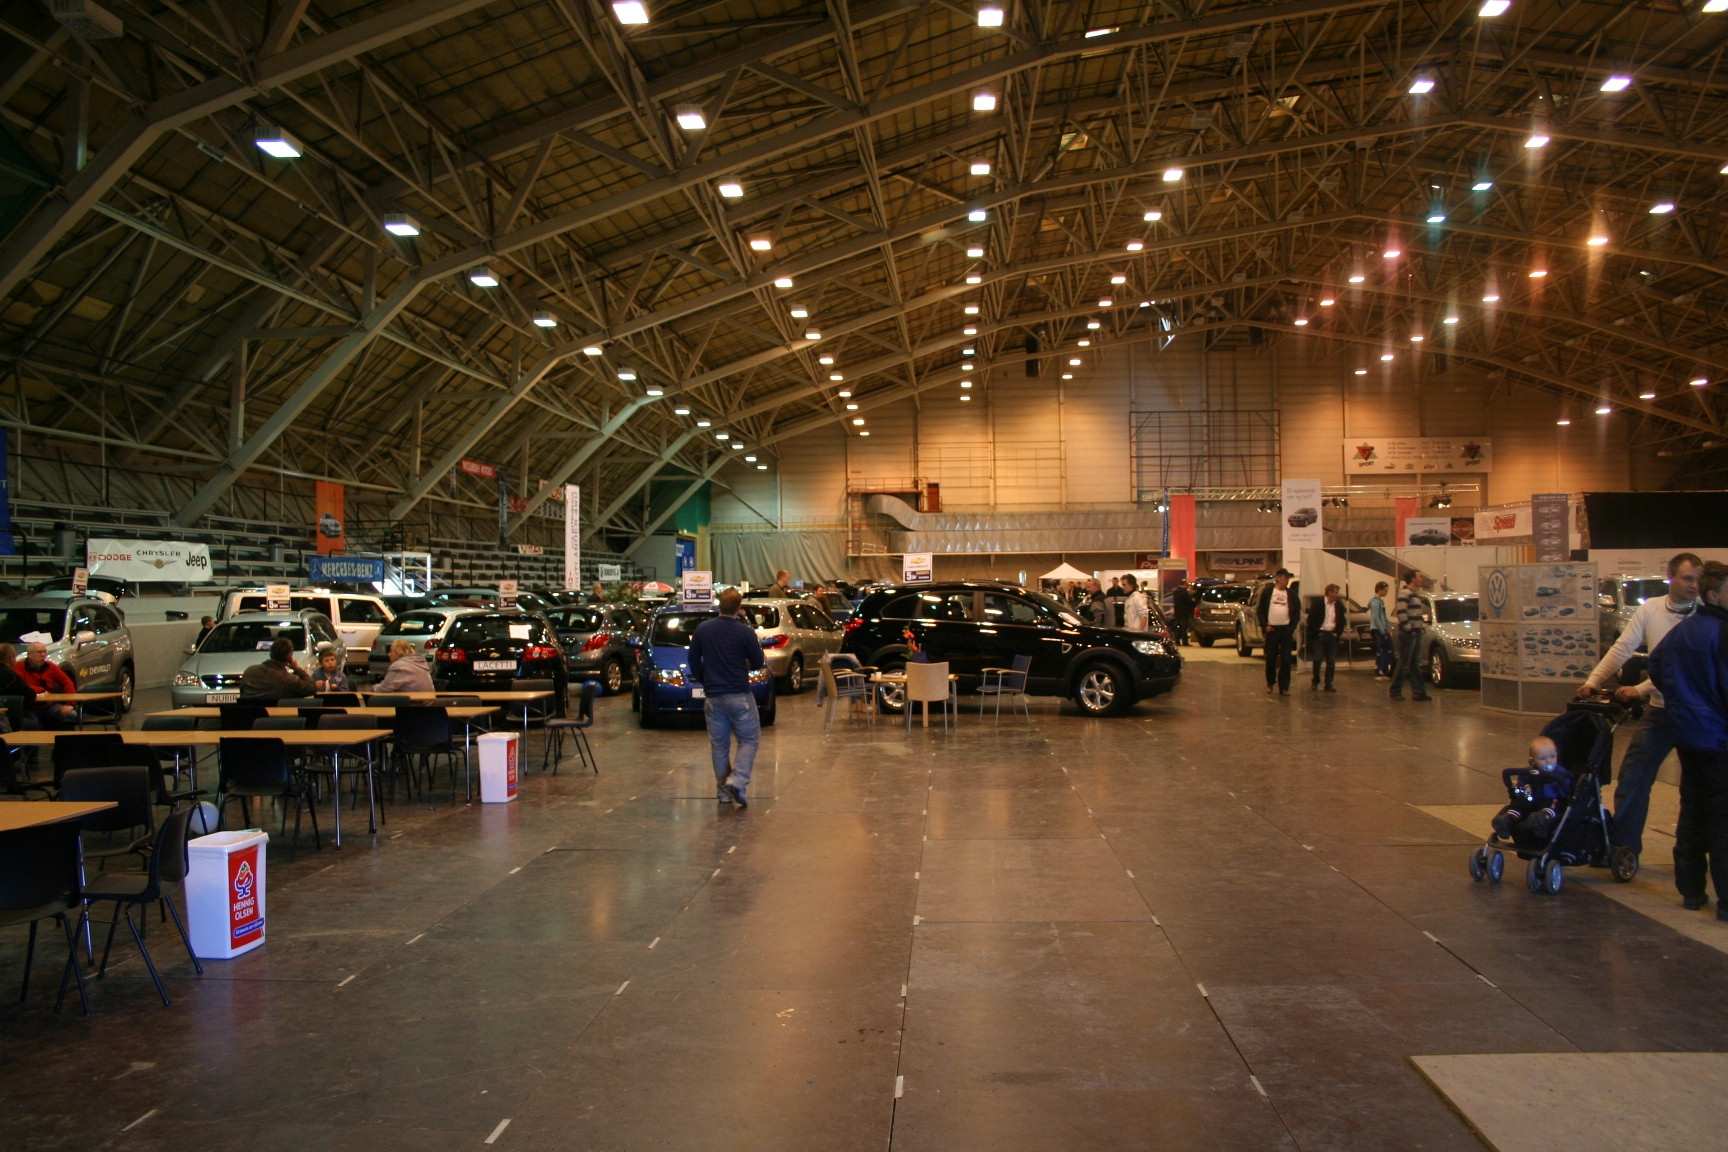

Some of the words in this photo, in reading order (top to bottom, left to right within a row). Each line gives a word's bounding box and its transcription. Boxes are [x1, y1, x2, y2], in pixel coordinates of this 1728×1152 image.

[98, 553, 132, 561] DODGE
[185, 551, 208, 570] Jeep
[233, 897, 255, 912] HENNIG
[234, 907, 254, 921] OLSEN
